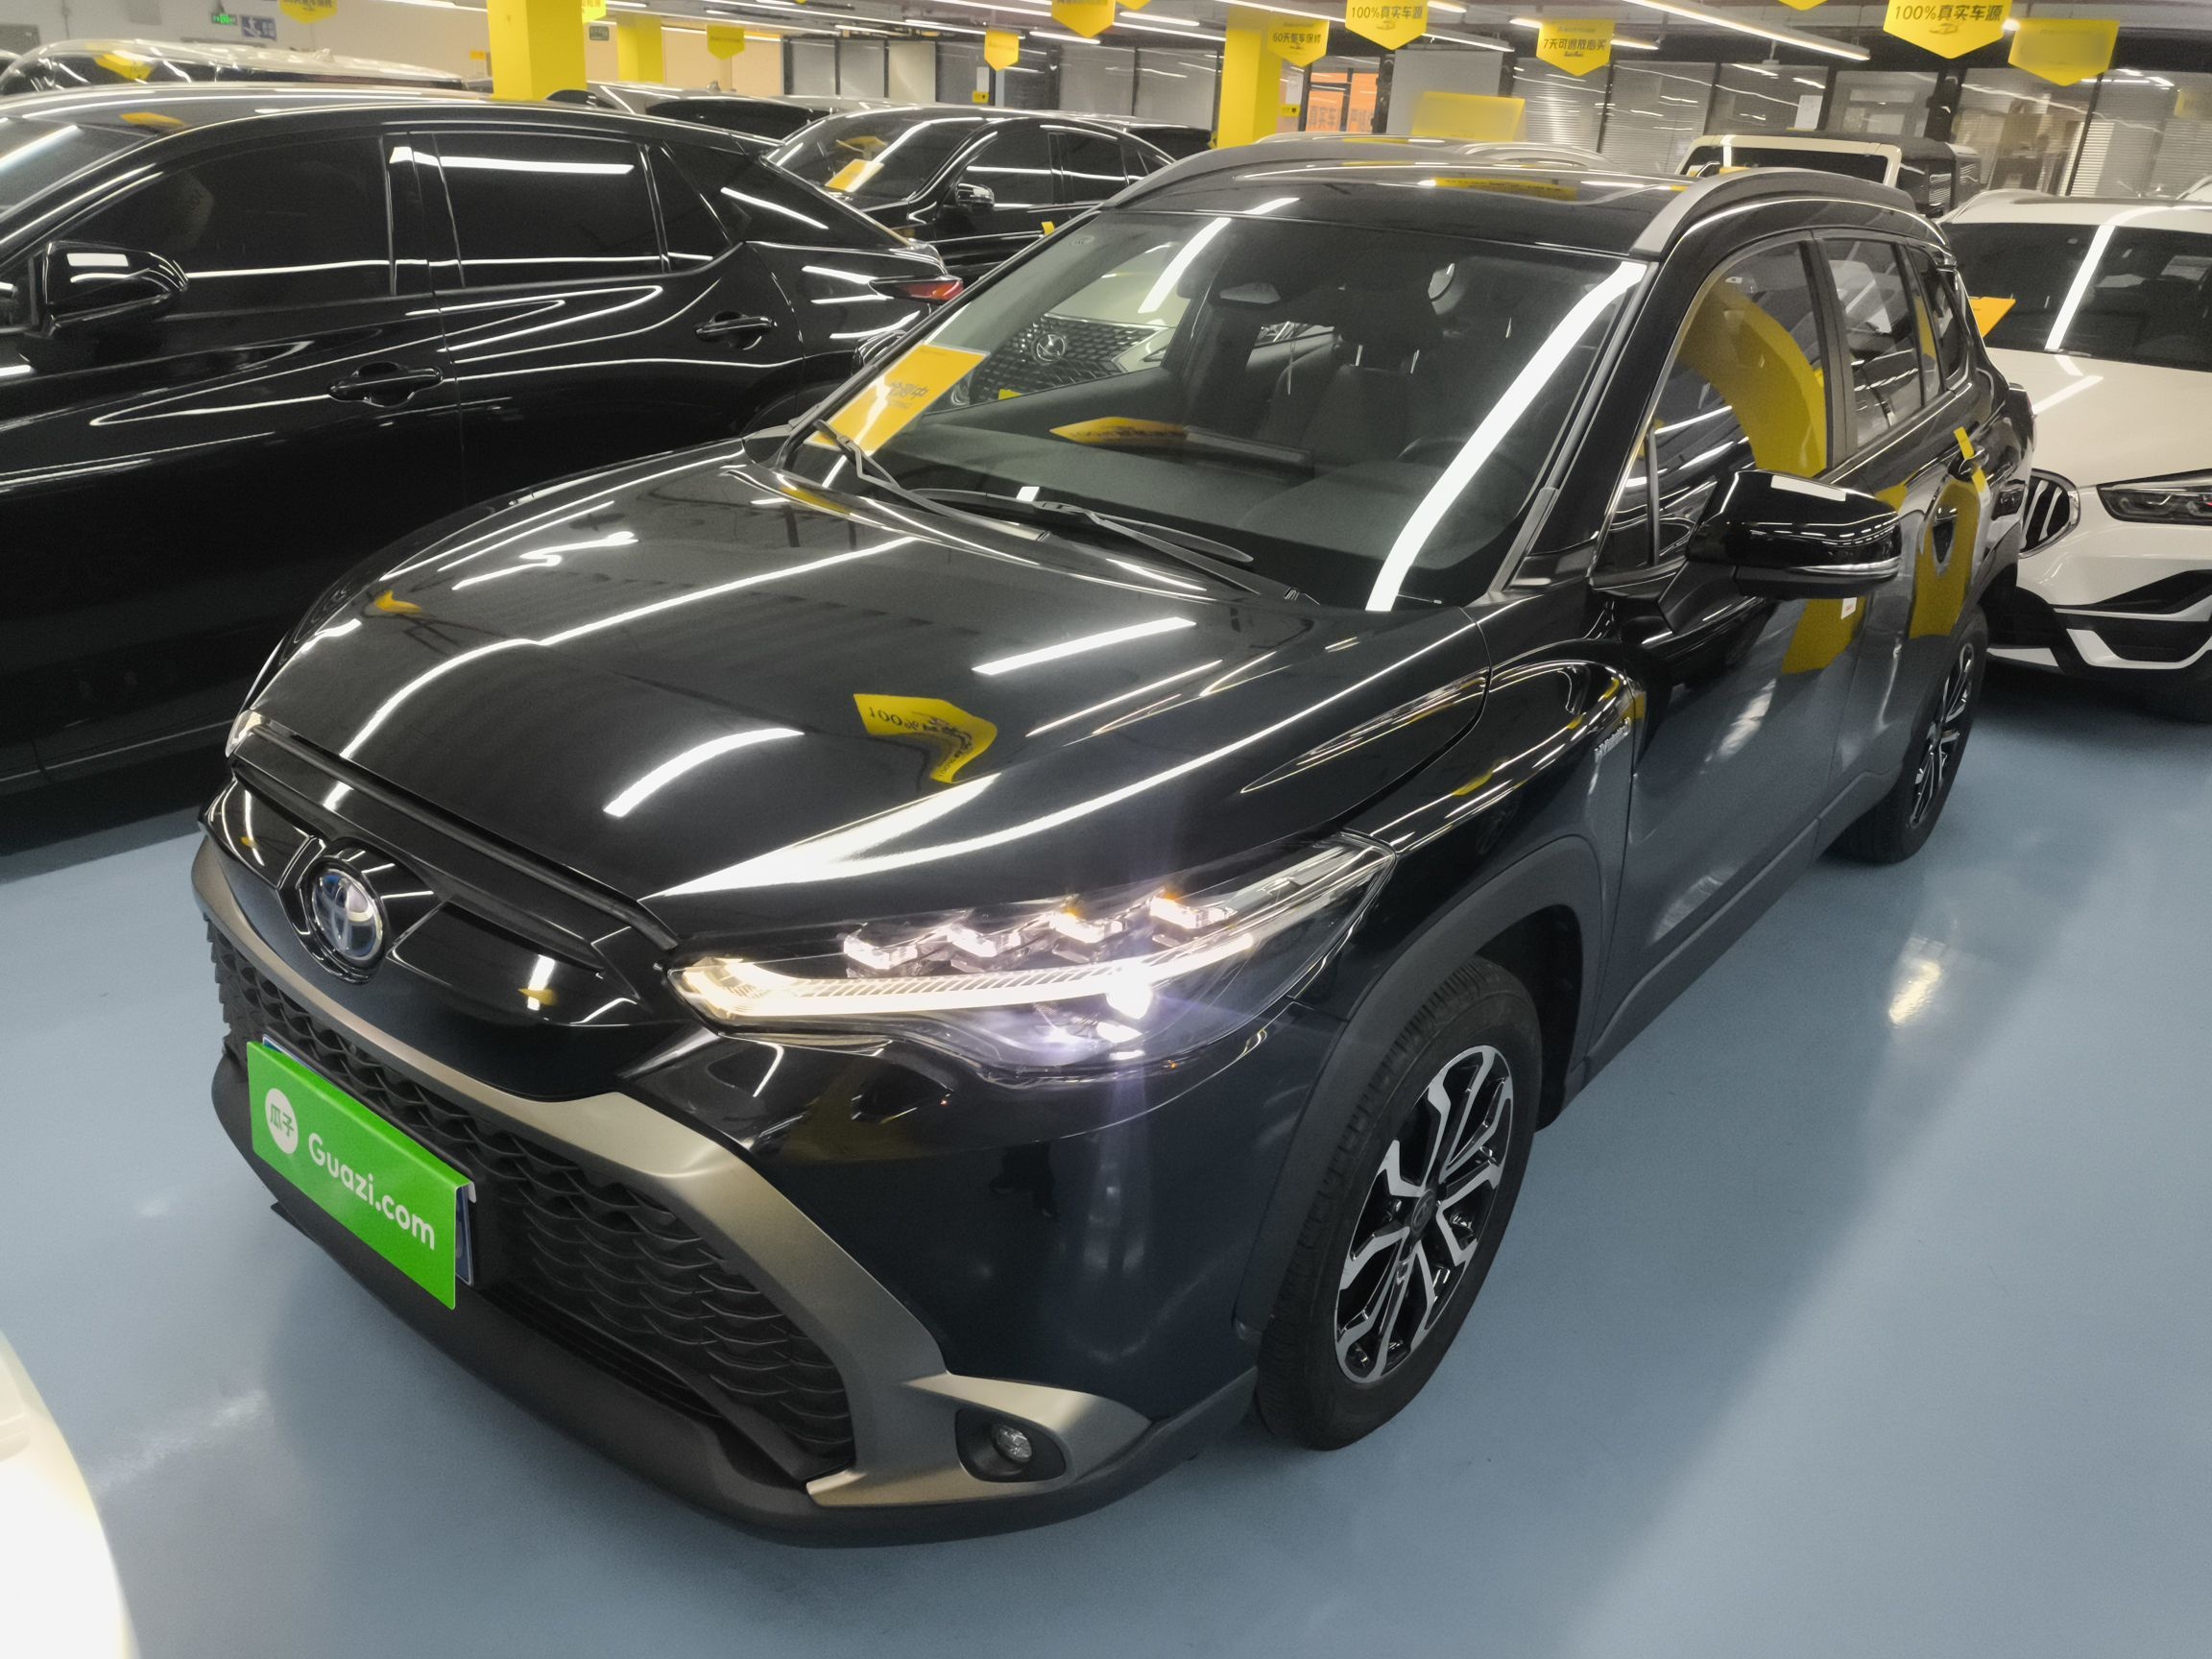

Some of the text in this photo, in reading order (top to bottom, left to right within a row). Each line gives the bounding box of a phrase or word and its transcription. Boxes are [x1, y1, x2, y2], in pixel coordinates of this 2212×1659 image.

[1895, 5, 2003, 21] 100%真实车源
[270, 1103, 295, 1137] 瓜子
[308, 1133, 435, 1251] Guazi.com
